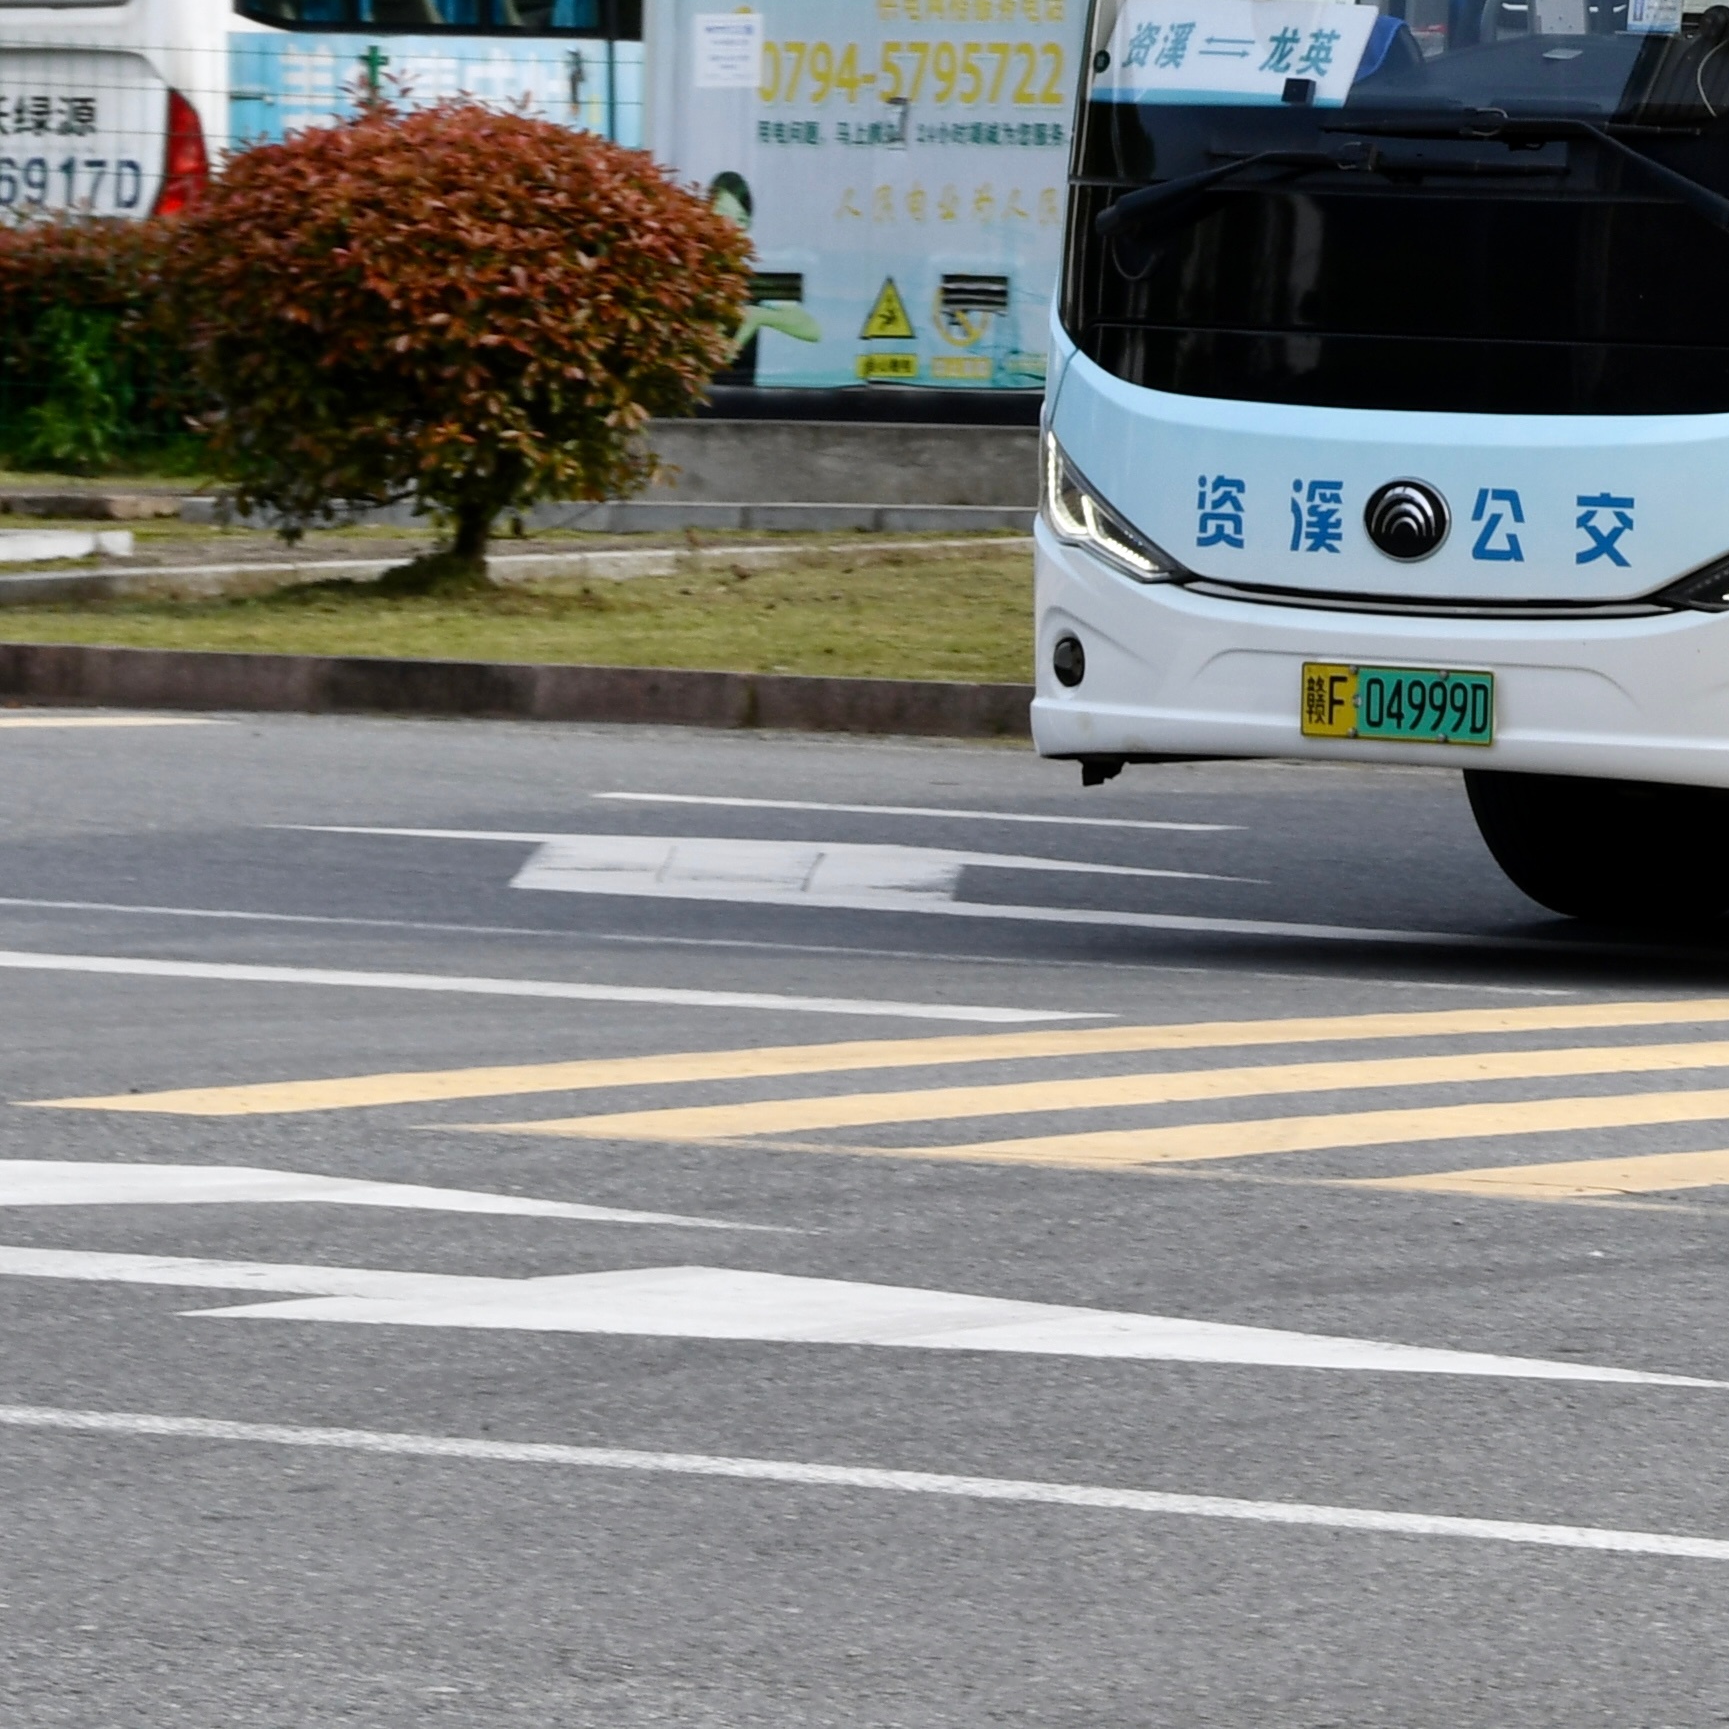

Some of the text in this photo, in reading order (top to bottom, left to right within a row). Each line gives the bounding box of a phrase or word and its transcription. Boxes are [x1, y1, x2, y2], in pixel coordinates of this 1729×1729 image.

[757, 41, 1064, 106] 0794-5795722
[1121, 21, 1341, 77] 资溪 龙英
[1196, 474, 1635, 568] 资溪 公交
[1365, 676, 1489, 736] 04999D
